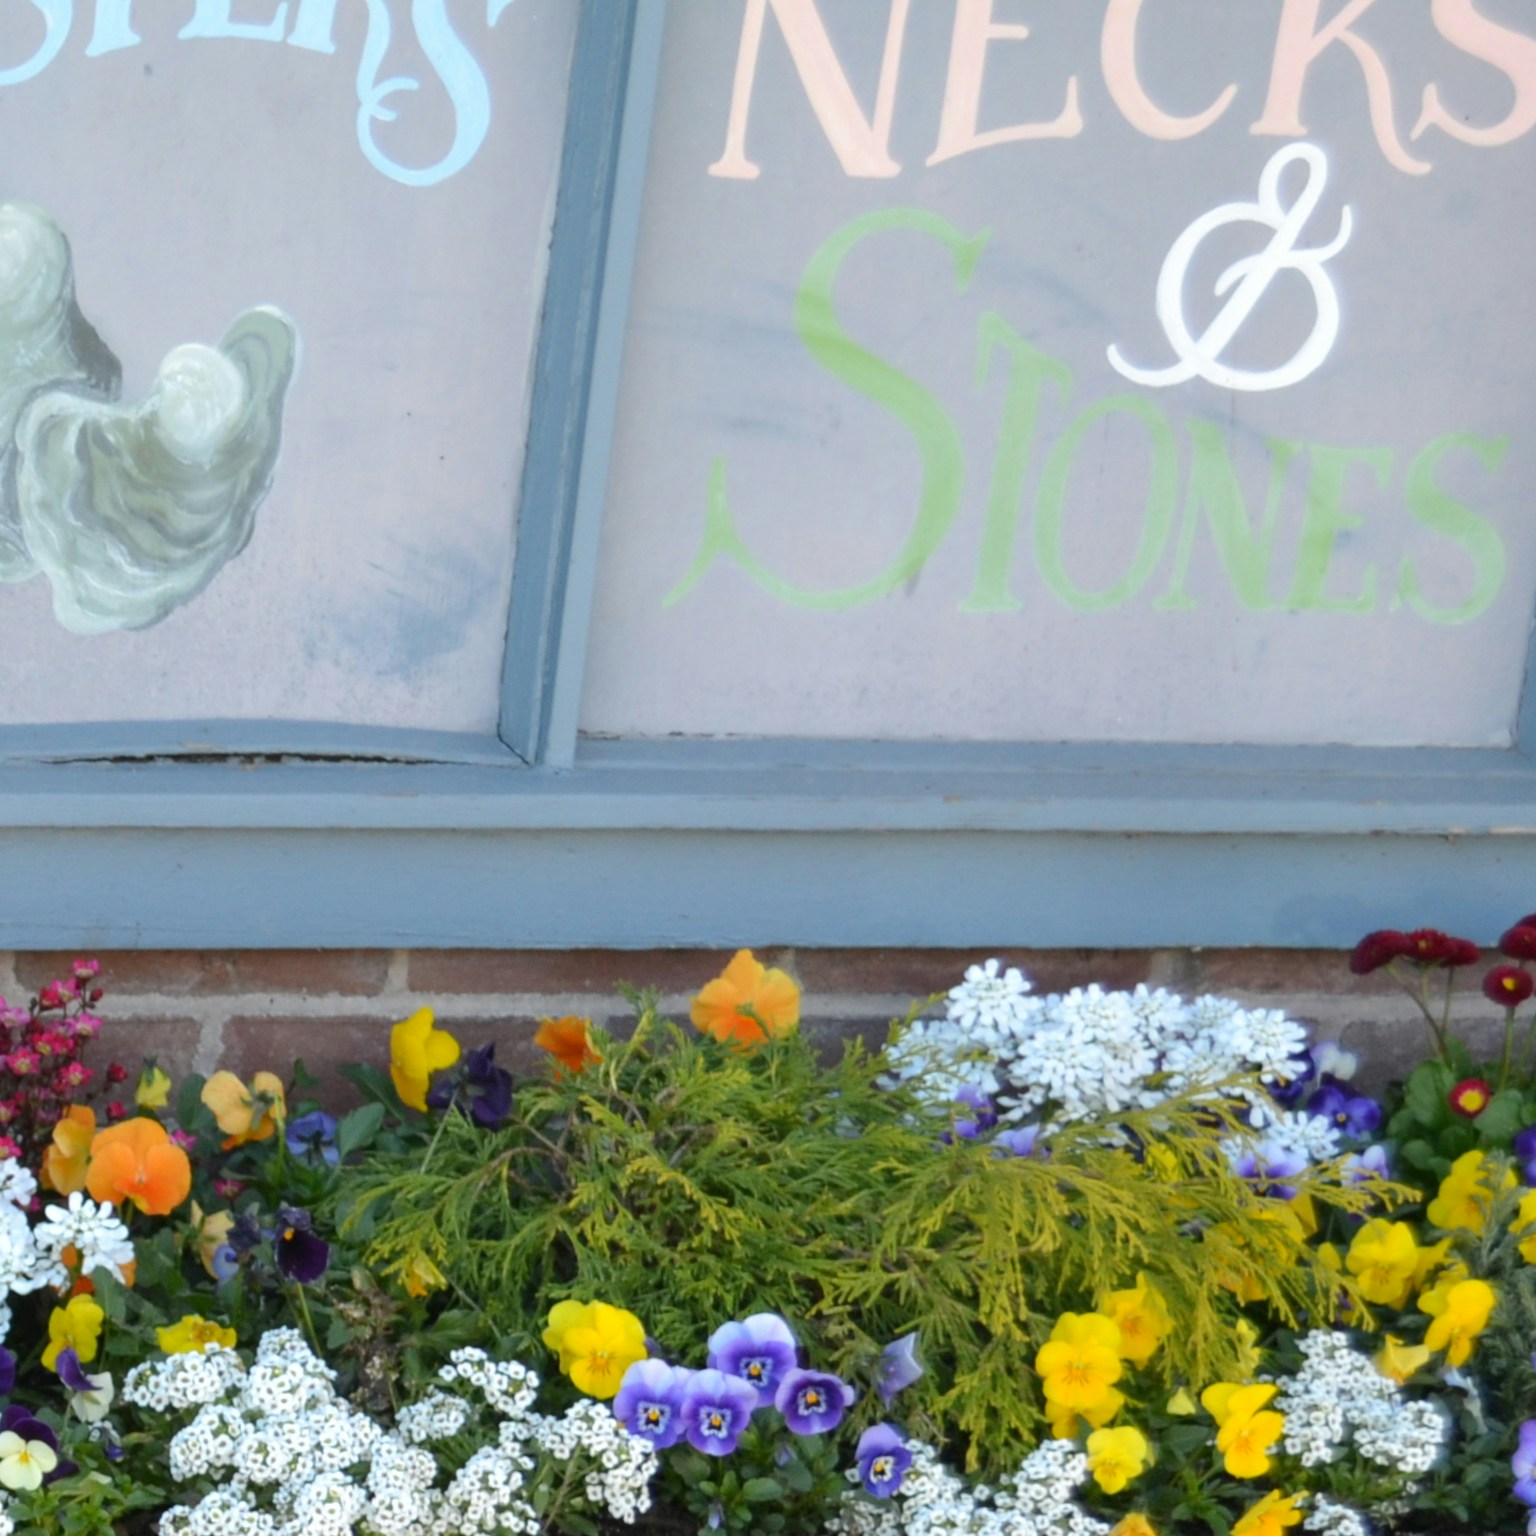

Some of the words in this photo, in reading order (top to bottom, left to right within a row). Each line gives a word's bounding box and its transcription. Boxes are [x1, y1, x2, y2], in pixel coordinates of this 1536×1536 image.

[708, 0, 1536, 178] NECKS
[1107, 142, 1352, 391] &
[661, 206, 1511, 625] STONES
